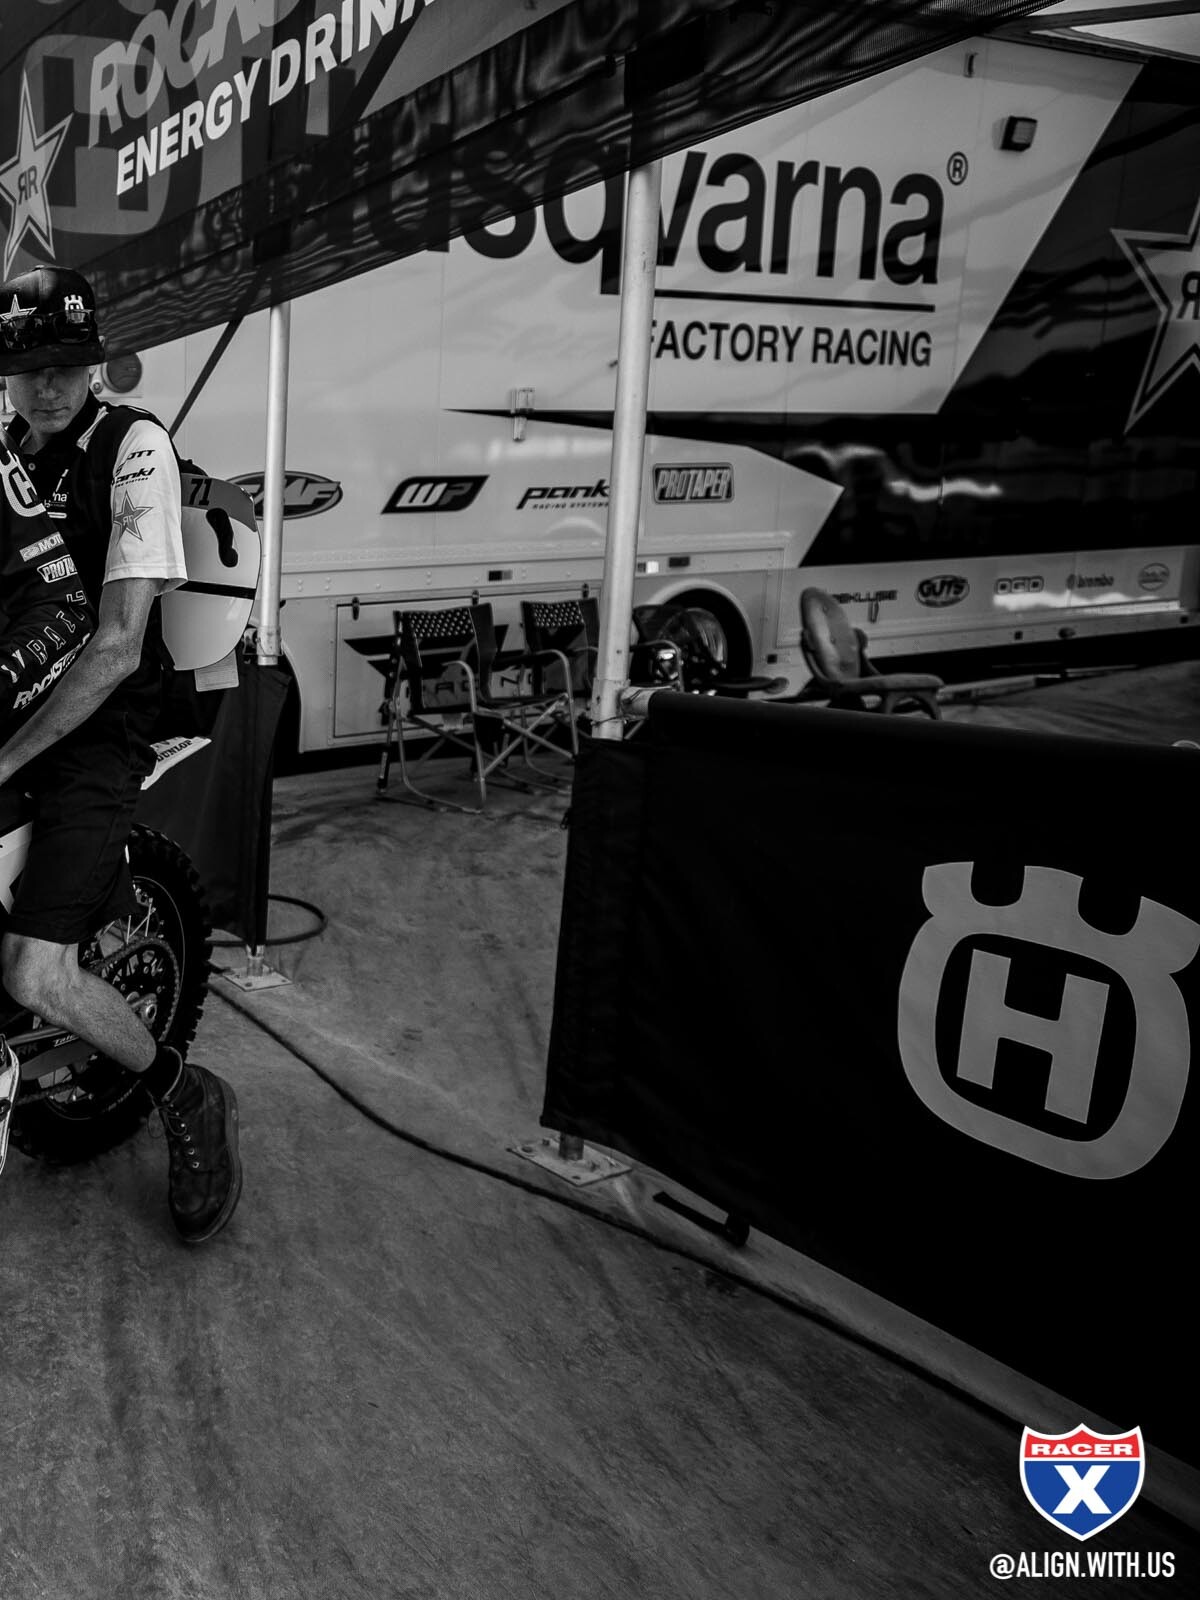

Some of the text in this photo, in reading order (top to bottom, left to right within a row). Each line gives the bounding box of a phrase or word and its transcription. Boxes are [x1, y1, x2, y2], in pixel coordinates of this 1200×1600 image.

[116, 58, 262, 196] ENERGY
[811, 327, 932, 366] RACING
[187, 478, 212, 505] 71
[516, 479, 612, 510] pank
[656, 466, 735, 501] PROTAPER
[917, 577, 969, 598] GUTS
